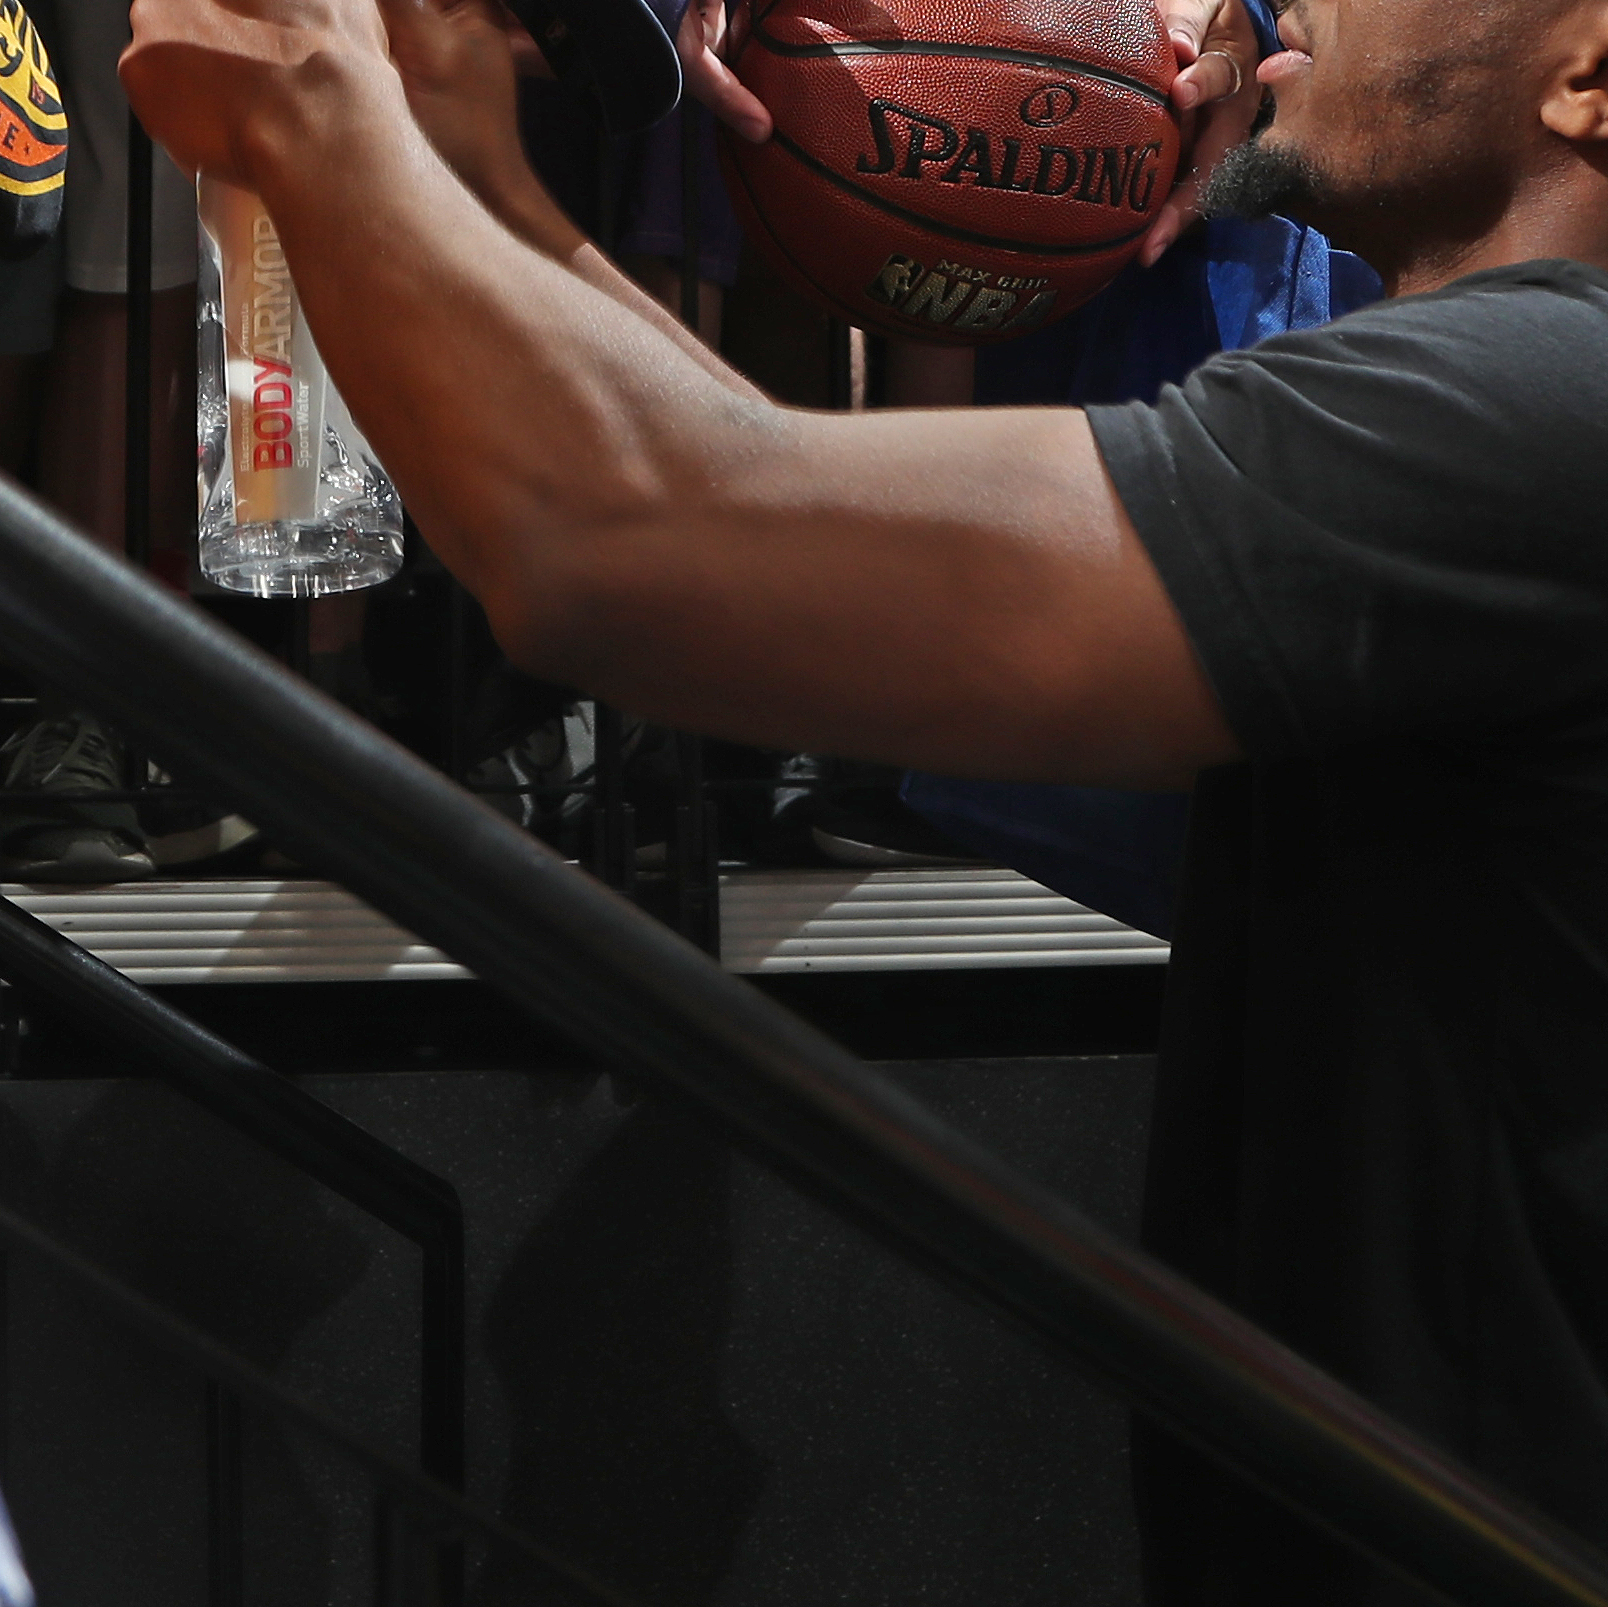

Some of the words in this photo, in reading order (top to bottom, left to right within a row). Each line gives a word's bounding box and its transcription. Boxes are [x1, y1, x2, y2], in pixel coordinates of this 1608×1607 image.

[855, 96, 1163, 214] SPALDING
[898, 269, 1059, 331] NBA
[935, 257, 992, 283] MAX
[240, 302, 250, 359] ormula
[297, 381, 310, 470] SportWater
